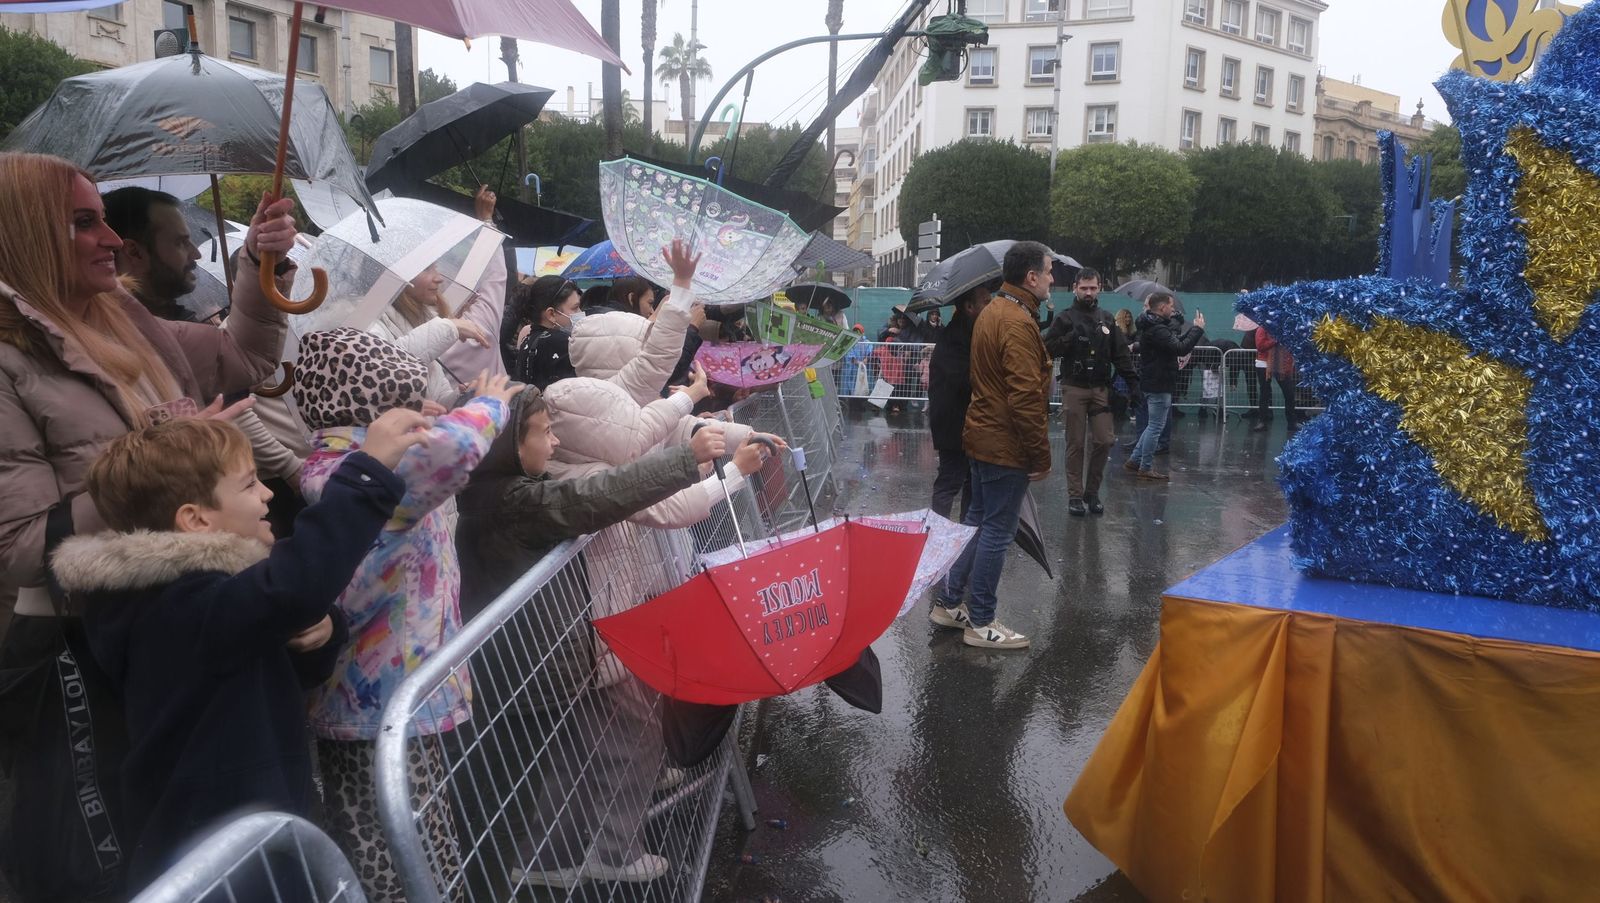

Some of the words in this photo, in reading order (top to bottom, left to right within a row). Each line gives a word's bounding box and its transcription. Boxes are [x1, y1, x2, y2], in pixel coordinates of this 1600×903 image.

[796, 321, 838, 340] MINECRAFT
[757, 568, 824, 617] MOUSE
[763, 602, 830, 646] MICKEY
[58, 648, 87, 714] LOLA
